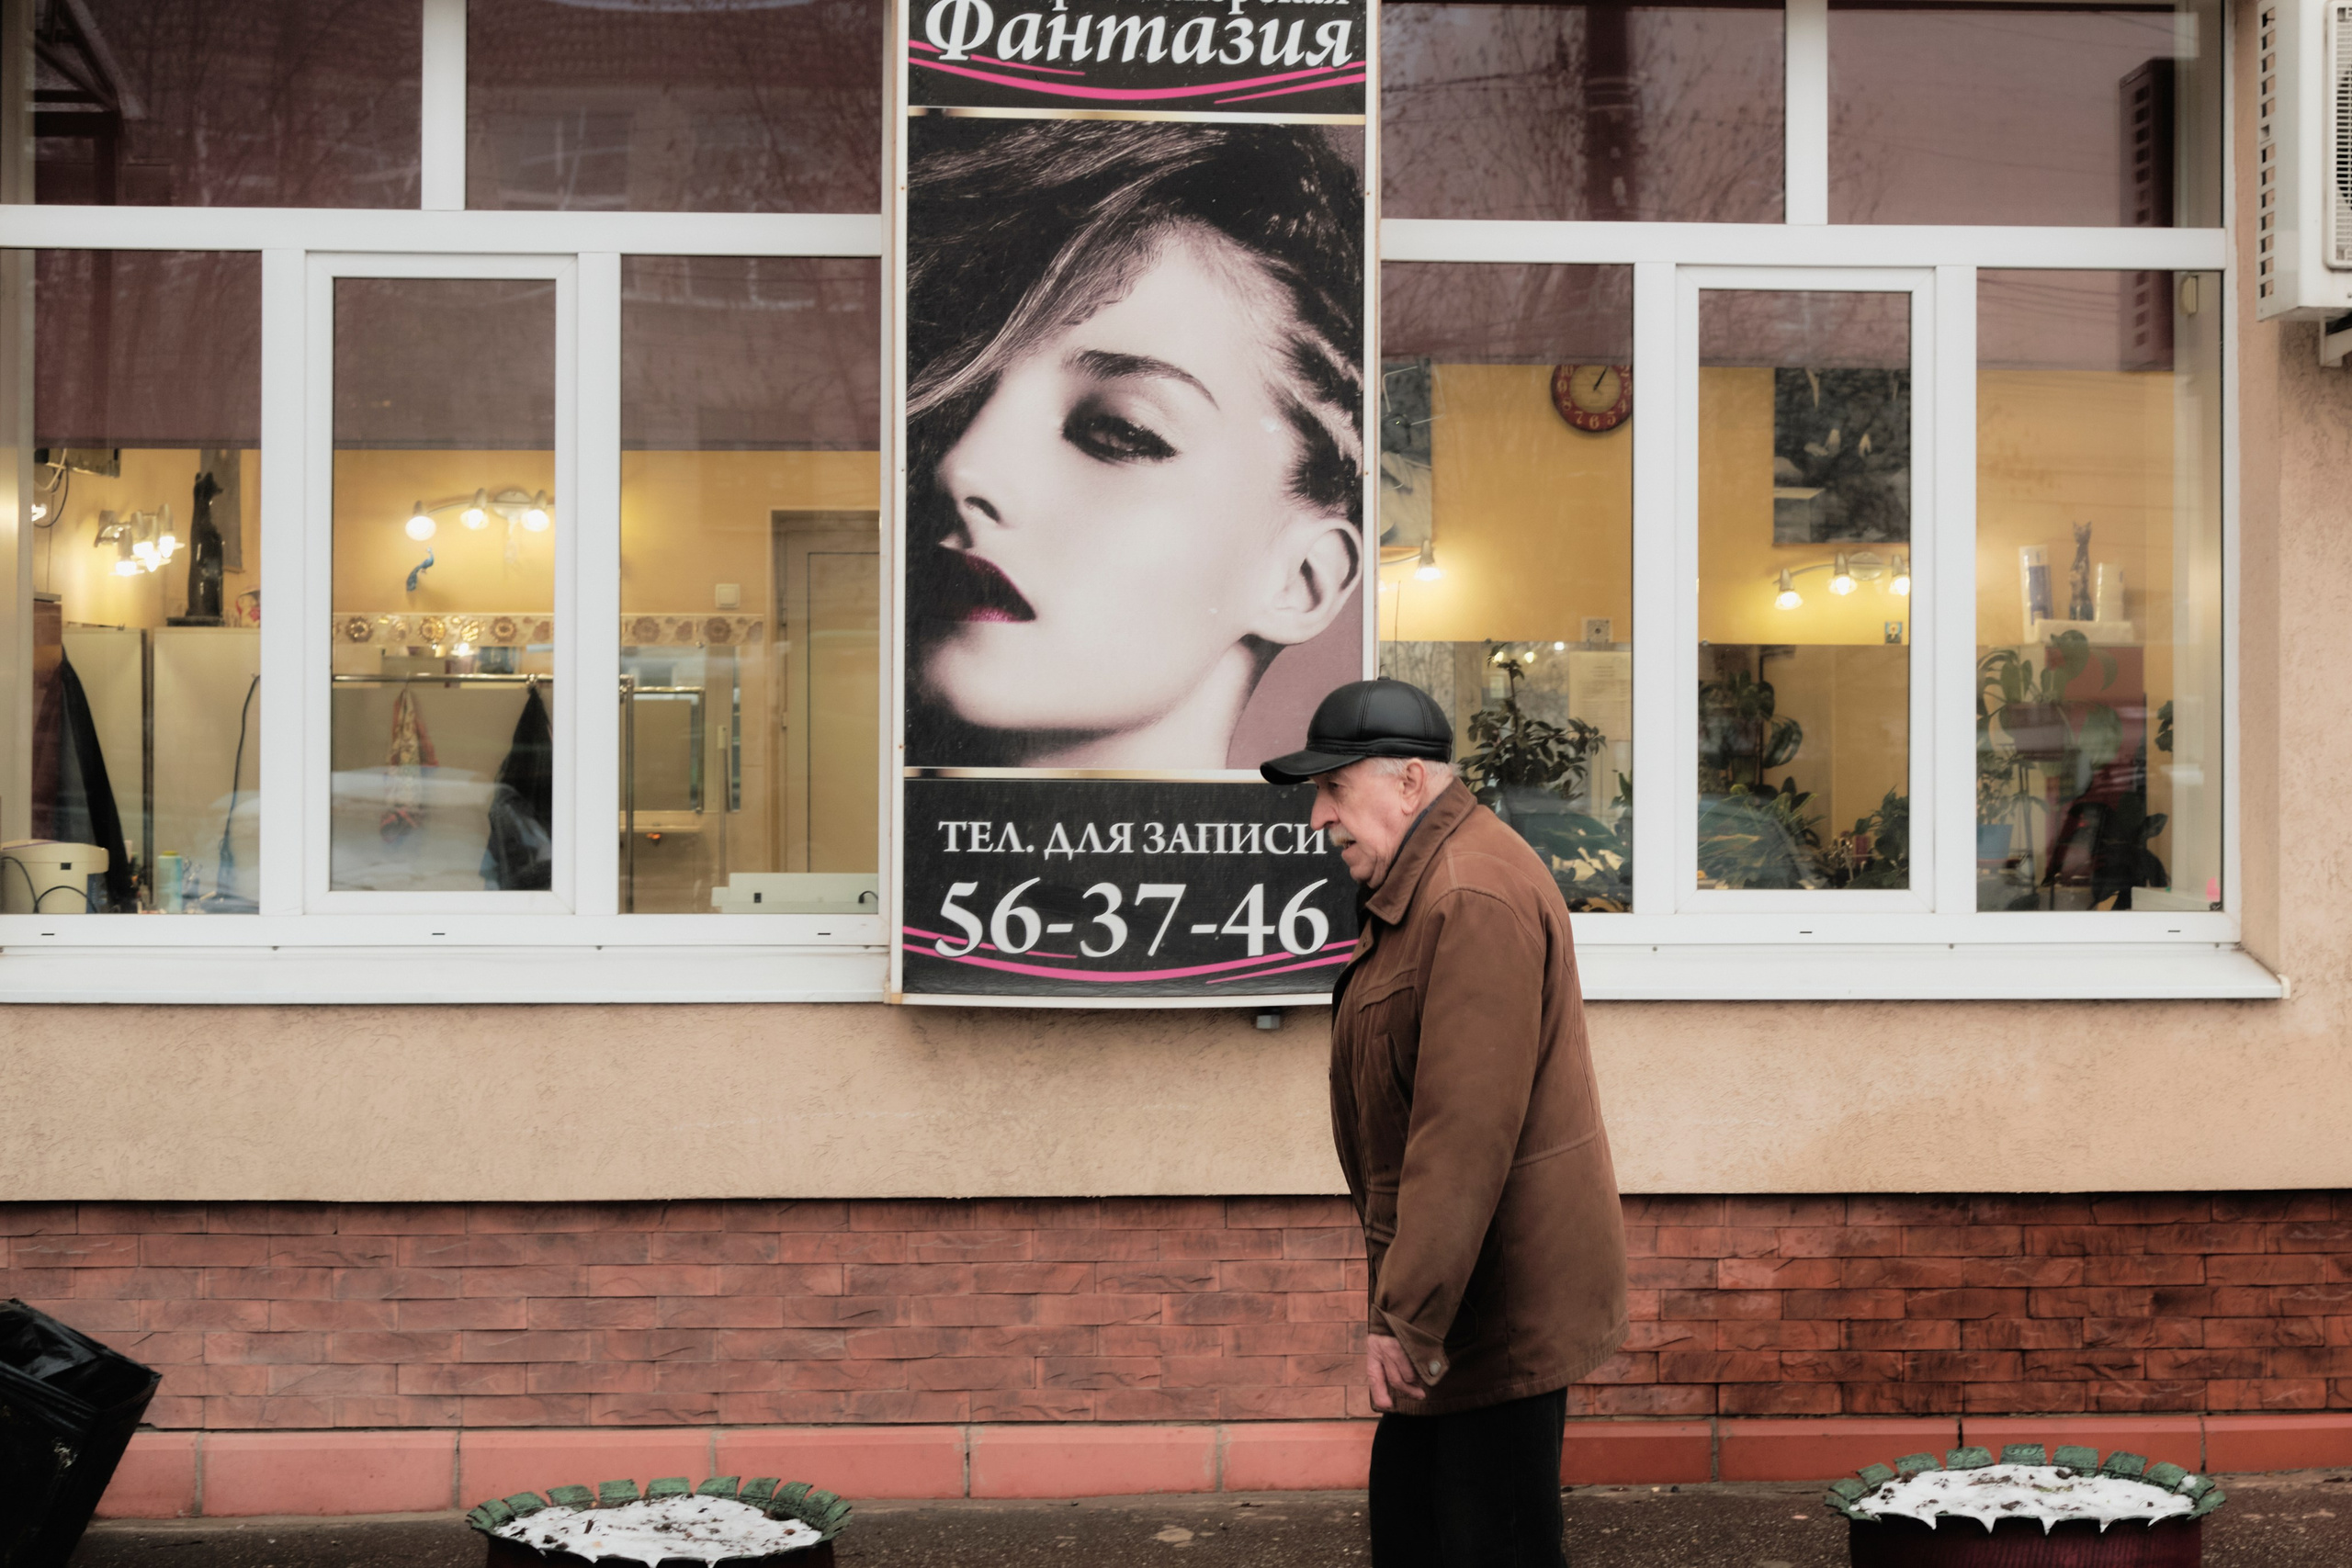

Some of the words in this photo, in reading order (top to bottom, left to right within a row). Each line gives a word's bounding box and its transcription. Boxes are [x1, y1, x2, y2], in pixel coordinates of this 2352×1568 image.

[925, 0, 1352, 67] Фантазия
[1557, 379, 1567, 393] 9
[1562, 397, 1572, 411] 8
[1574, 411, 1583, 424] 7
[1589, 415, 1600, 429] 6
[1607, 411, 1616, 425] 5
[938, 820, 1035, 853] ТЕЛ.
[1044, 822, 1135, 861] ДЛЯ
[1142, 822, 1329, 855] ЗАПИСИ
[934, 877, 1329, 958] 56-37-46
